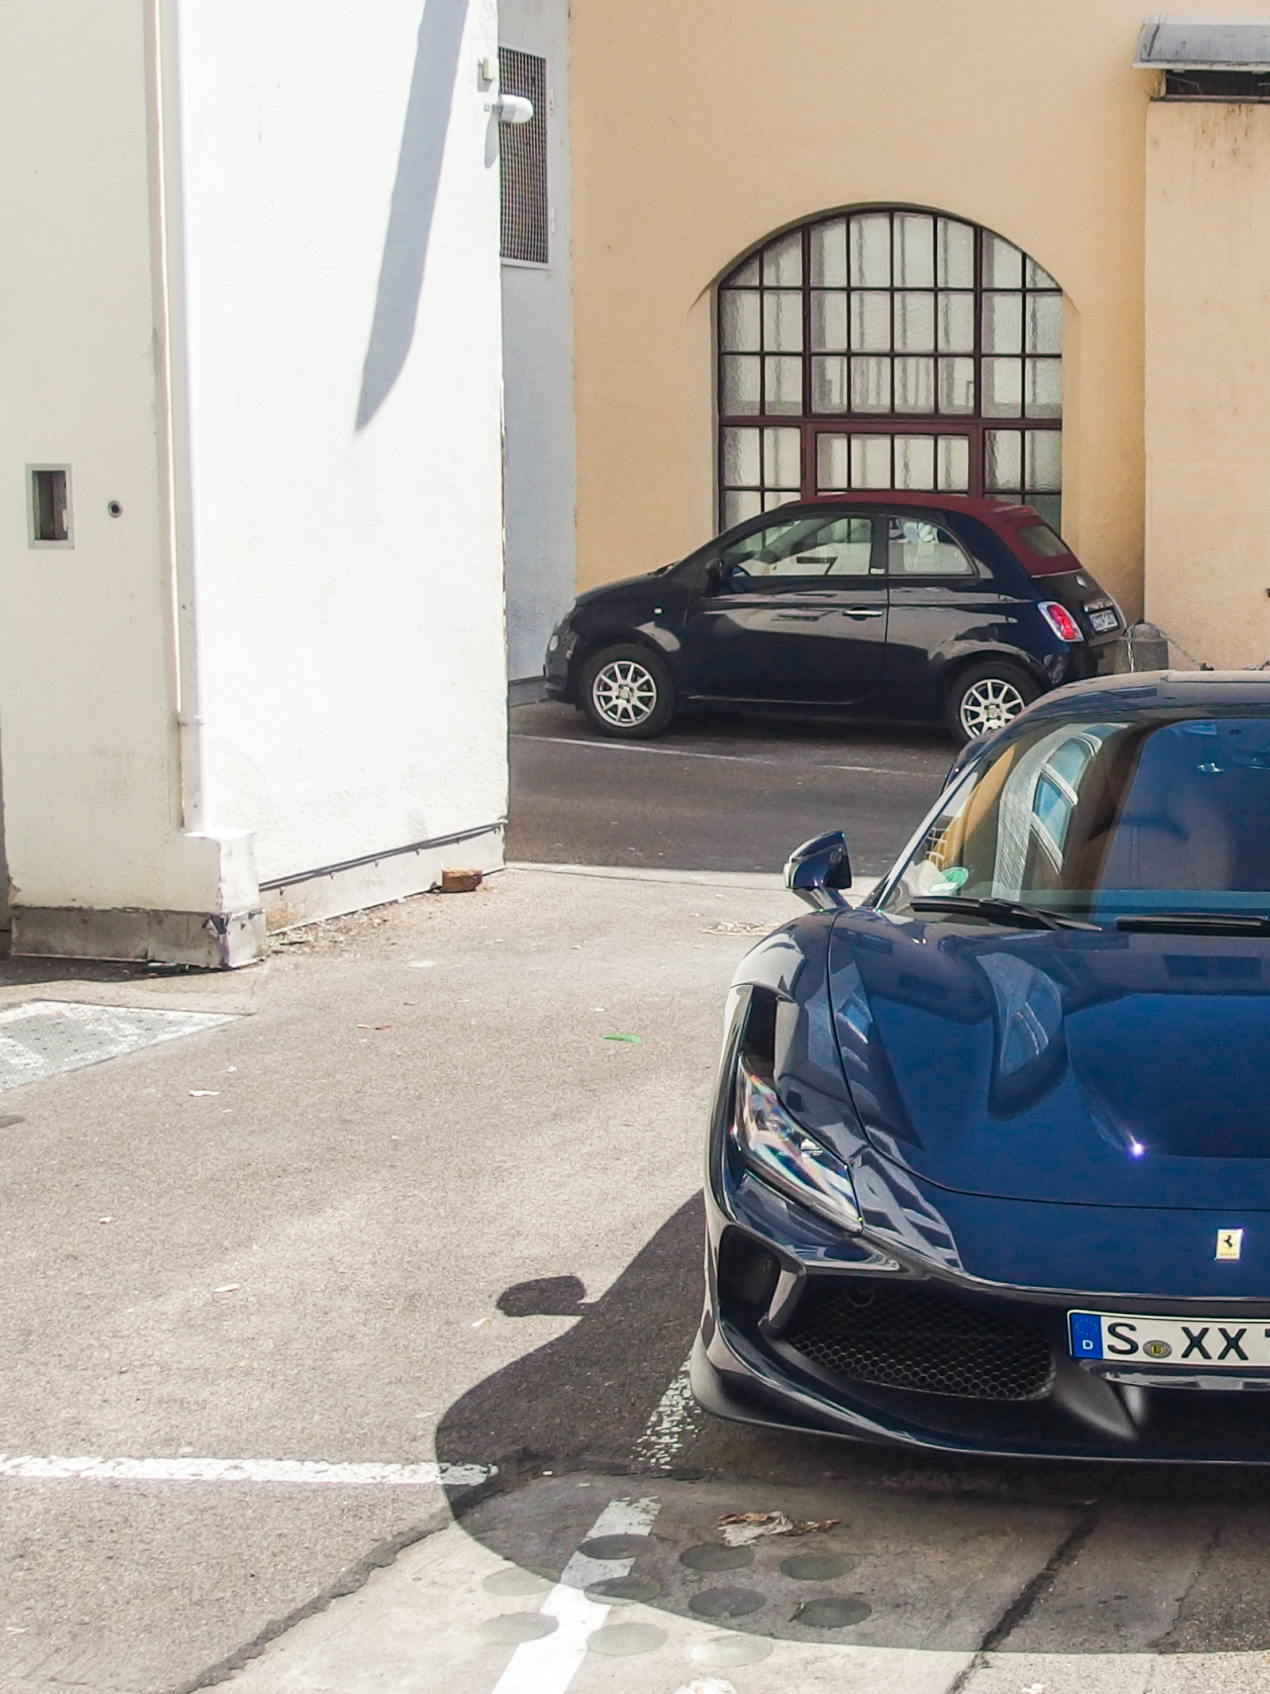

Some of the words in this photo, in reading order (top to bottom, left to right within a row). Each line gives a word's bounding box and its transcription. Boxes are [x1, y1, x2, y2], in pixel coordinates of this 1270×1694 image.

[1082, 1339, 1094, 1350] D
[1107, 1322, 1139, 1355] S
[1180, 1326, 1249, 1361] XX
